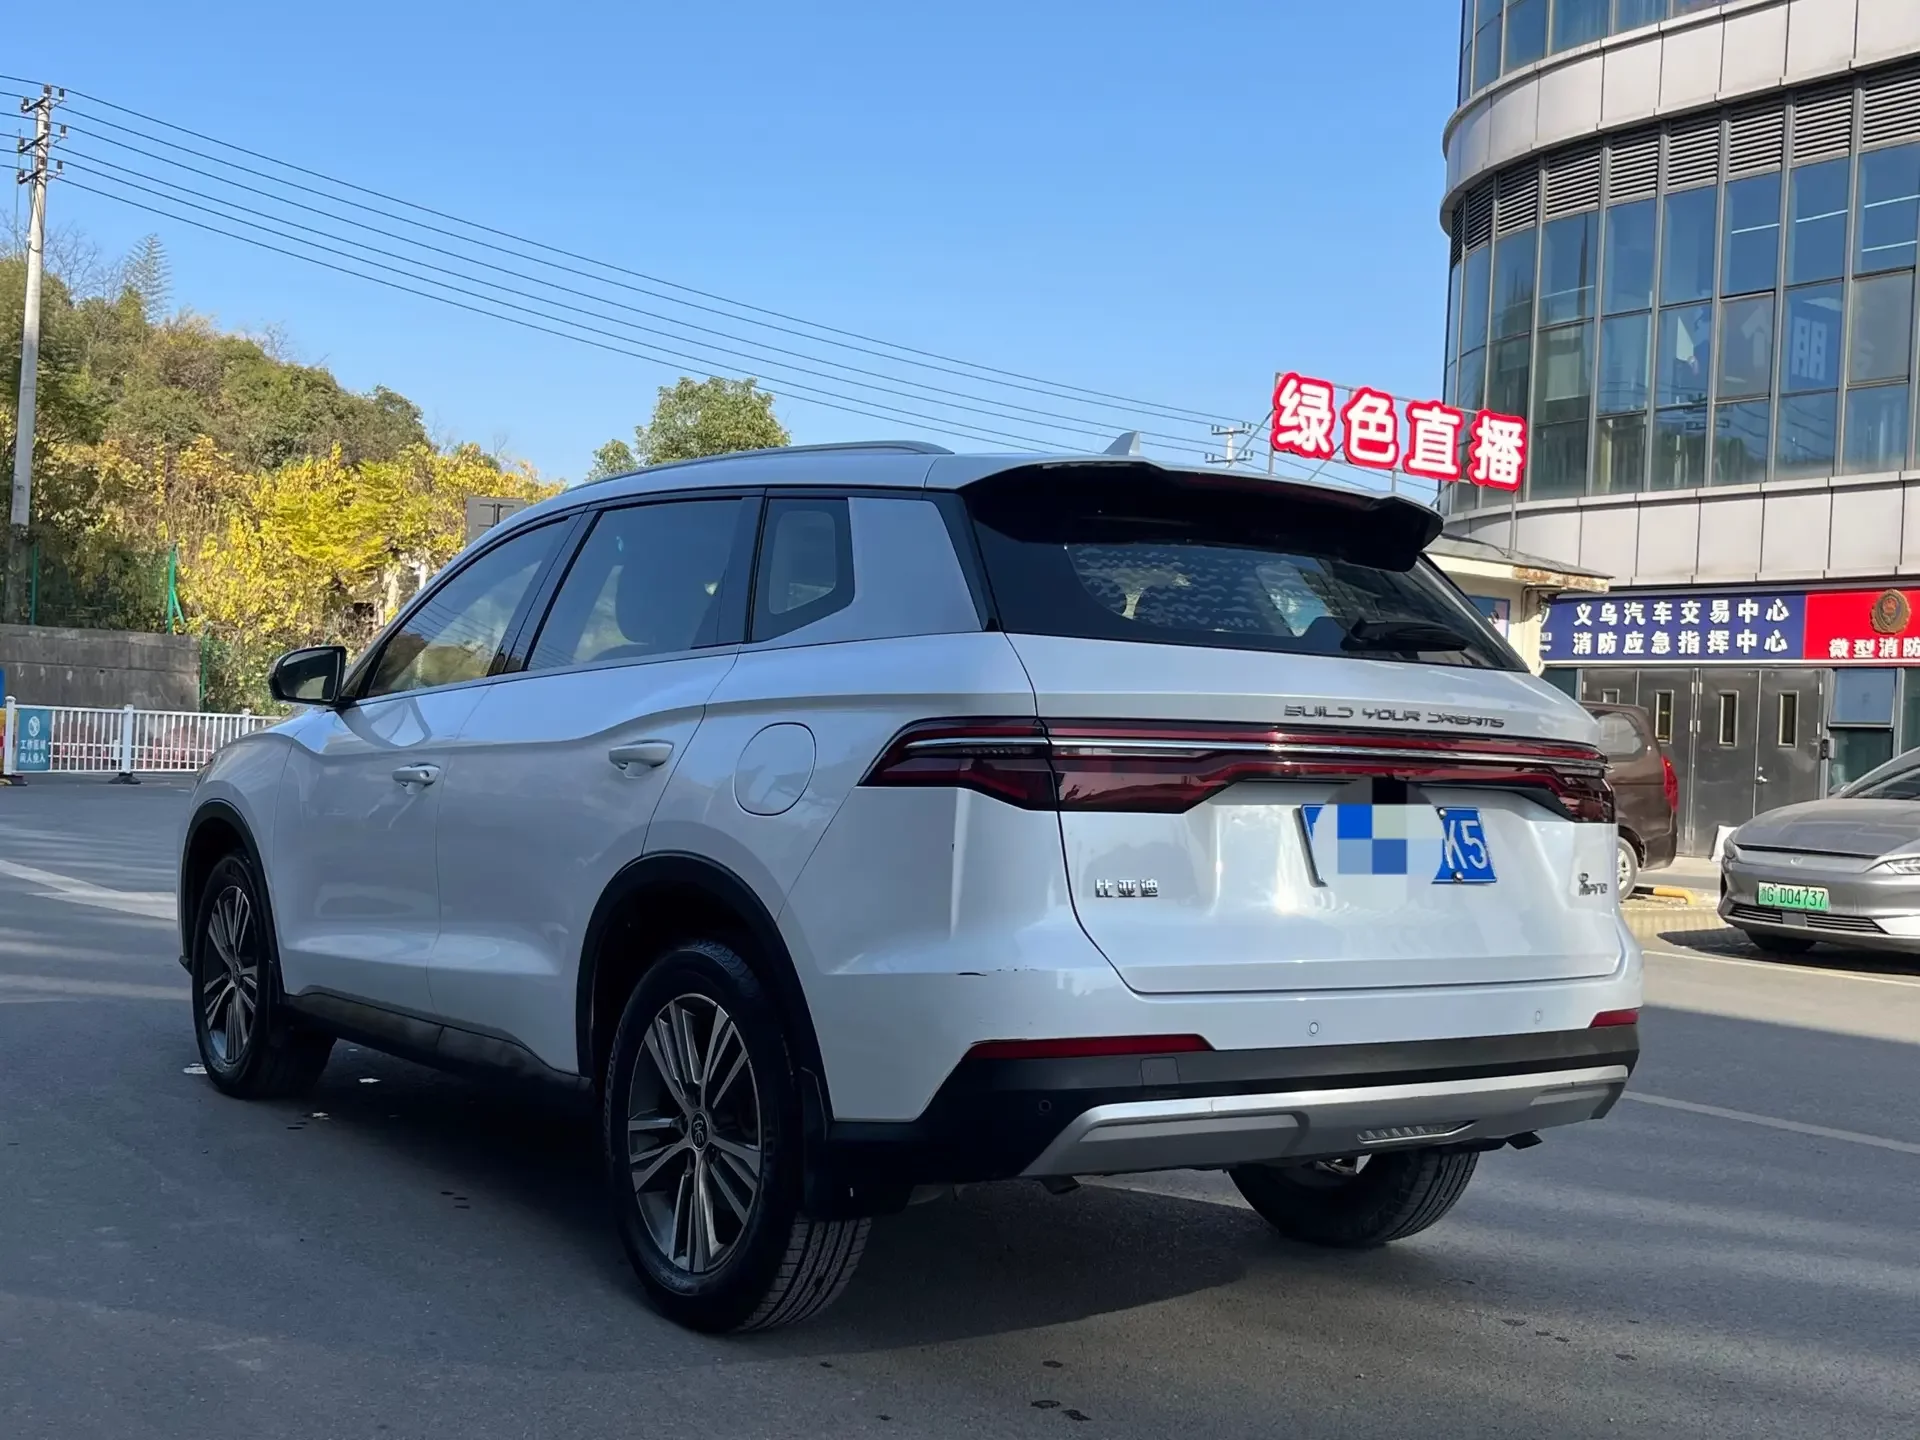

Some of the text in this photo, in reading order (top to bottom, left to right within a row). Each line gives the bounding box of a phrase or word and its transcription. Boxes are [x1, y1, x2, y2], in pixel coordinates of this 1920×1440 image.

[1273, 373, 1526, 490] 绿色直播
[1573, 598, 1789, 626] 义乌汽车交易中心
[1572, 629, 1788, 655] 消防应急指挥中心
[1829, 637, 1920, 659] 微型消防
[1284, 704, 1354, 719] BUILD
[1362, 708, 1421, 722] YOUR
[1095, 879, 1158, 897] 比亚迪
